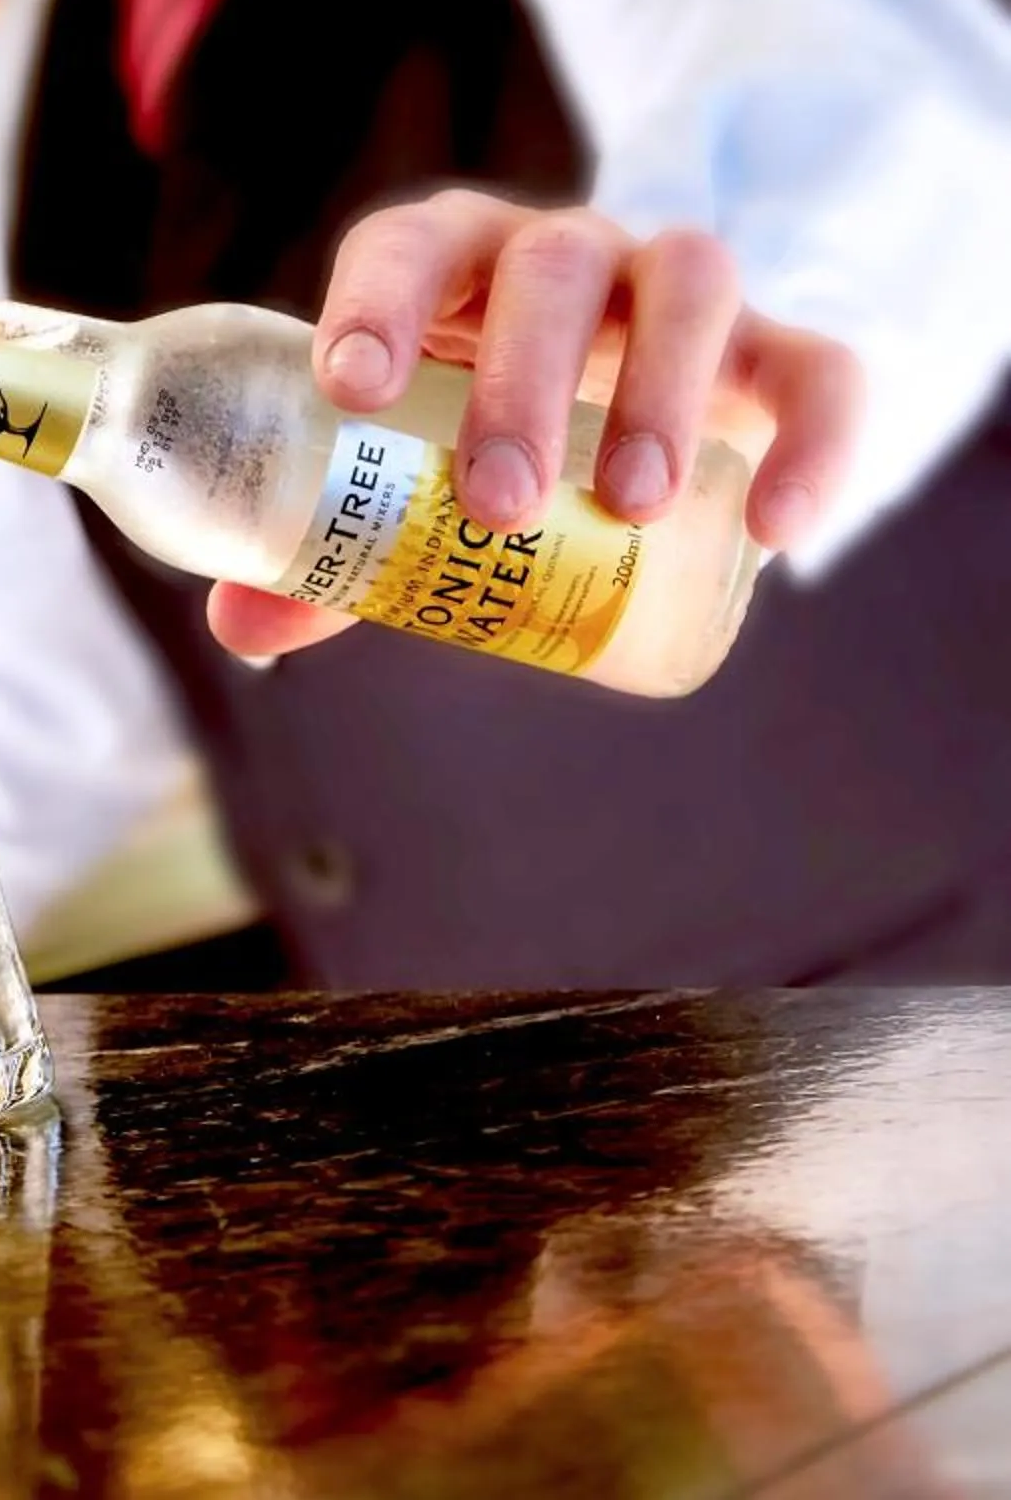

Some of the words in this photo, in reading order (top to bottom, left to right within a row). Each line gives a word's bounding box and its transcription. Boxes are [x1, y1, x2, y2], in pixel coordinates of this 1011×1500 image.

[290, 440, 385, 603] EVER-TREE
[370, 482, 396, 532] MIXERS
[417, 493, 456, 573] INDIAN
[612, 530, 643, 589] 200ml
